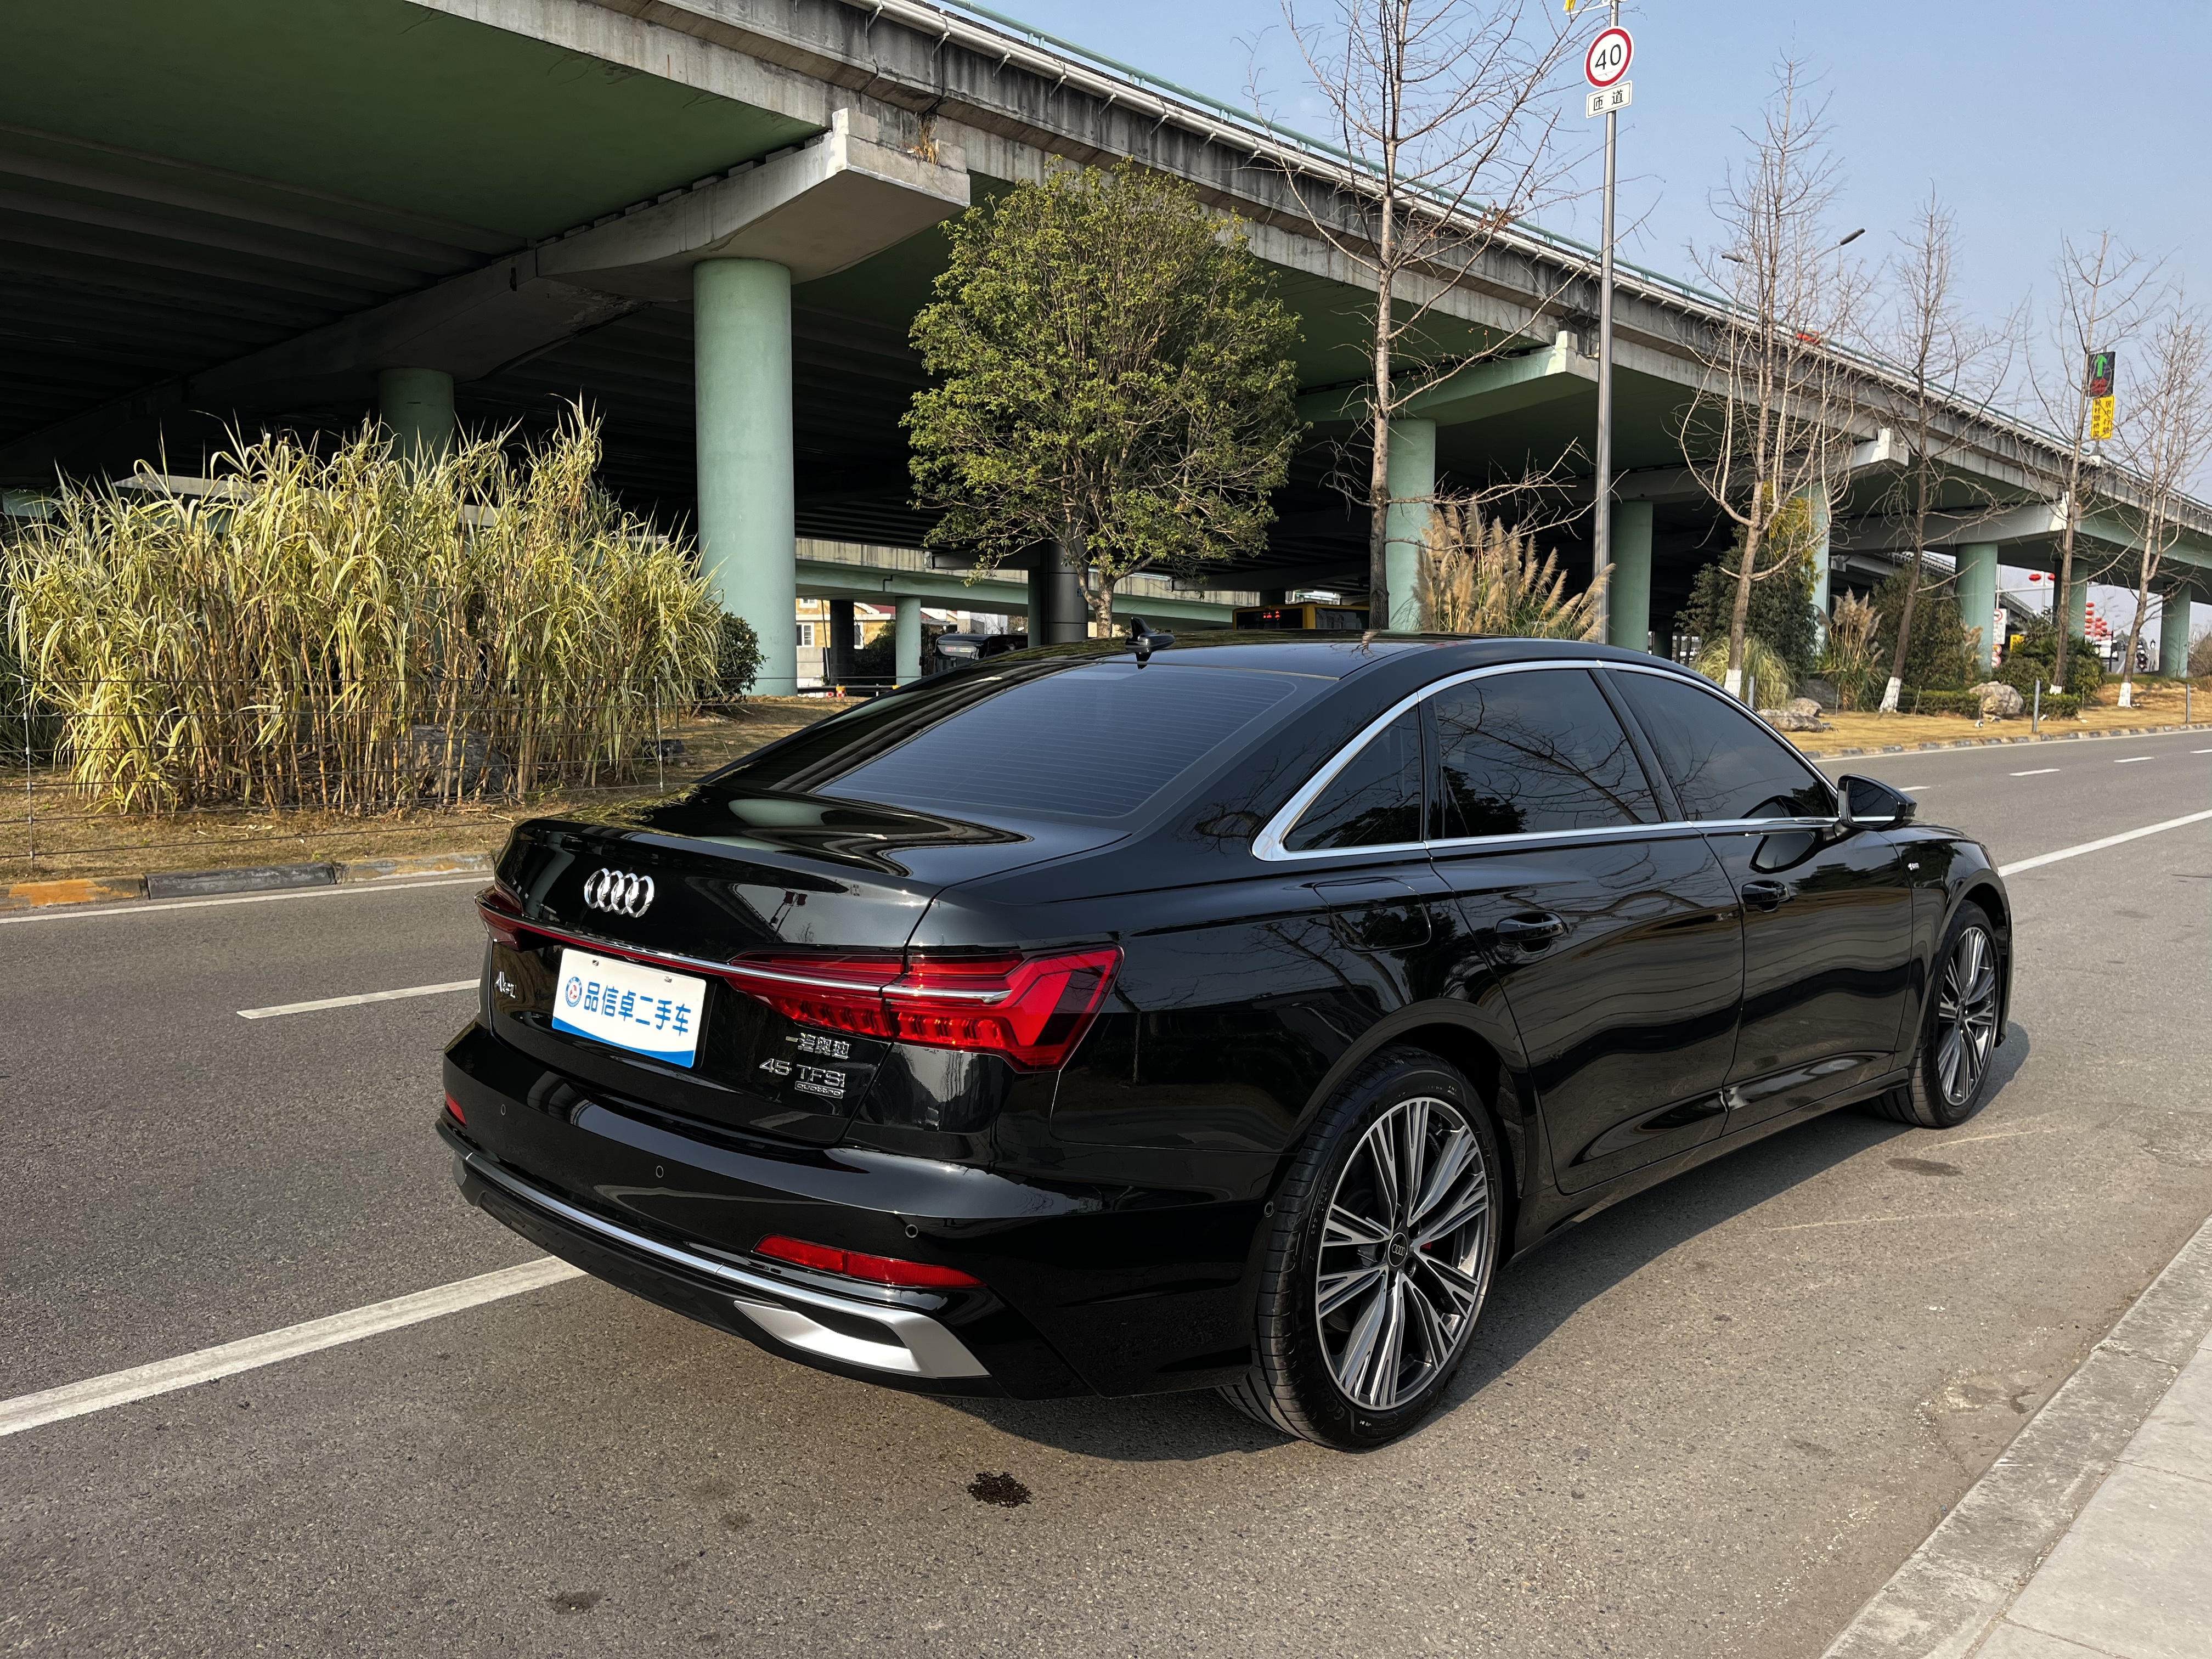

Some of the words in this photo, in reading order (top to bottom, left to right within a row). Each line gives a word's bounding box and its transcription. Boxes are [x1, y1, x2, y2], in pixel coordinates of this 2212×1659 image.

[1595, 44, 1622, 70] 40
[1593, 88, 1623, 111] 匝道
[584, 981, 691, 1036] 品信卓二手车
[759, 1058, 792, 1076] 45
[797, 1064, 846, 1088] TFSI
[796, 1082, 842, 1097] quattro
